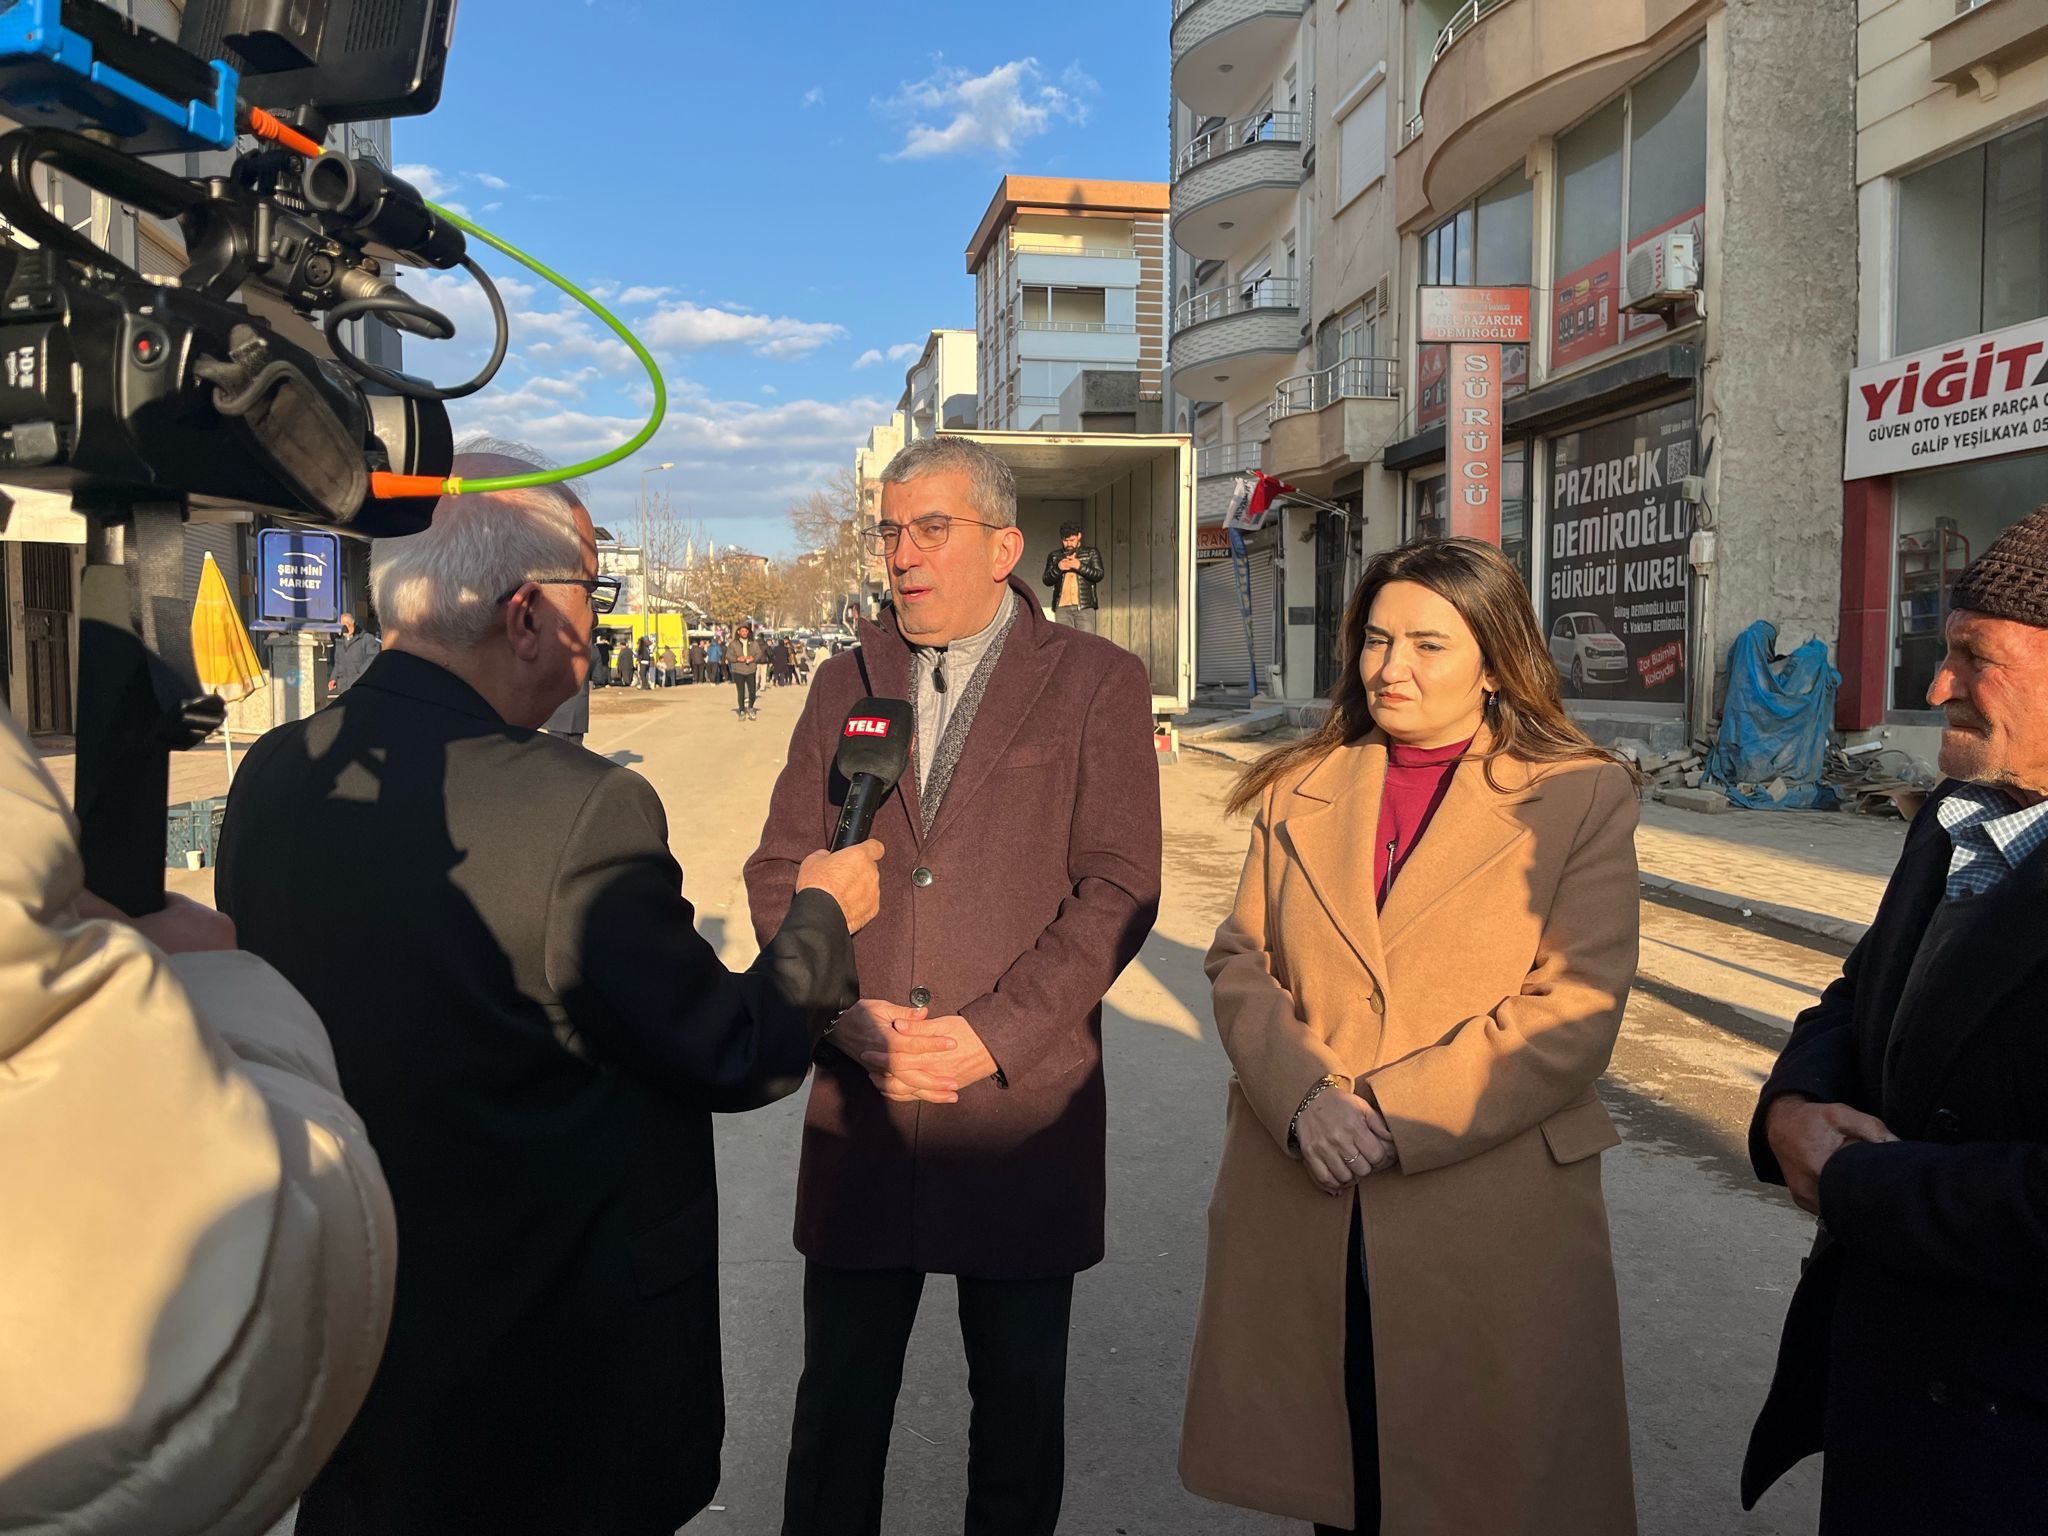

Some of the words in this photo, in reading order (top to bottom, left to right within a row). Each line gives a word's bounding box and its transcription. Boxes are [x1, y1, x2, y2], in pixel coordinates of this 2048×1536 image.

[1464, 315, 1523, 326] PAZARCIK
[1868, 422, 1910, 442] GÜVEN
[1914, 416, 1940, 433] OTO
[1943, 405, 1988, 427] YEDEK
[1992, 395, 2039, 415] PARÇA
[1911, 435, 1949, 456] GALİP
[1953, 421, 2028, 449] YEŞİLKAYA
[1553, 447, 1662, 510] PAZARCIK
[1196, 532, 1229, 548] RAN
[1552, 496, 1690, 559] DEMİROĞLU
[277, 564, 298, 576] ŞEN
[300, 564, 323, 577] MİNİ
[279, 577, 321, 589] MARKET
[1551, 558, 1617, 600] SÜRÜCÜ
[848, 719, 886, 734] TELE
